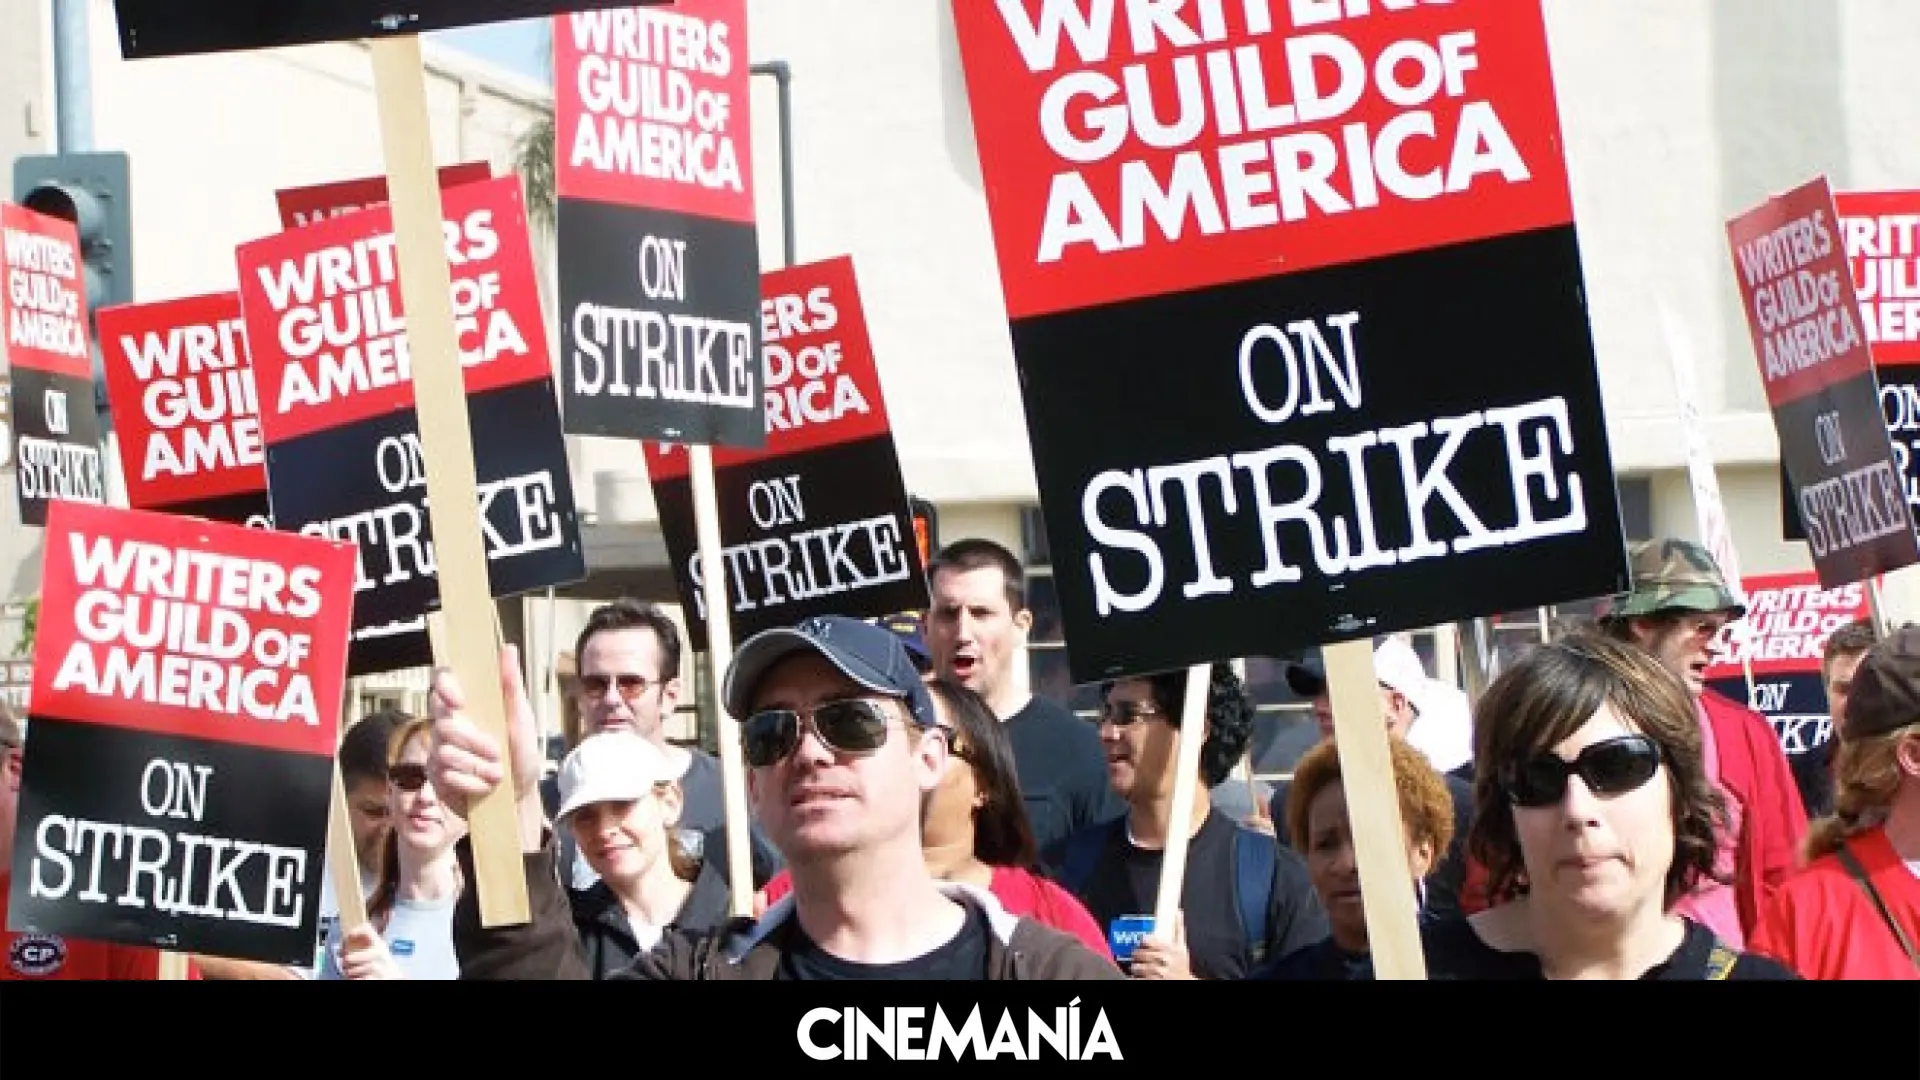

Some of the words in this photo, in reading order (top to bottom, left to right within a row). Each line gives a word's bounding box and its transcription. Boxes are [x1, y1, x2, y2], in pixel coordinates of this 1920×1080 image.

[570, 8, 732, 76] WRITERS
[577, 55, 693, 124] GUILD
[694, 89, 731, 133] OF
[1039, 32, 1366, 163] GUILD
[1374, 31, 1479, 106] OF
[571, 113, 744, 193] AMERICA
[1037, 101, 1531, 264] AMERICA
[256, 210, 499, 311] WRITRS
[639, 234, 687, 302] ON
[1738, 209, 1831, 289] WRITERS
[10, 308, 87, 358] AMERICA
[1753, 270, 1819, 332] GUILD
[573, 302, 755, 409] STRIKE
[796, 341, 843, 377] OF
[1238, 311, 1363, 425] ON
[1762, 304, 1860, 383] AMERICA
[749, 475, 805, 530] ON
[1081, 396, 1588, 616] STRIKE
[1800, 459, 1907, 558] STRIKE
[69, 533, 322, 618] WRITERS
[74, 590, 250, 659] GUILD
[252, 628, 311, 670] OF
[54, 643, 319, 725] AMERICA
[1752, 683, 1792, 711] ON
[141, 759, 212, 821] ON
[30, 815, 306, 927] STRIKE
